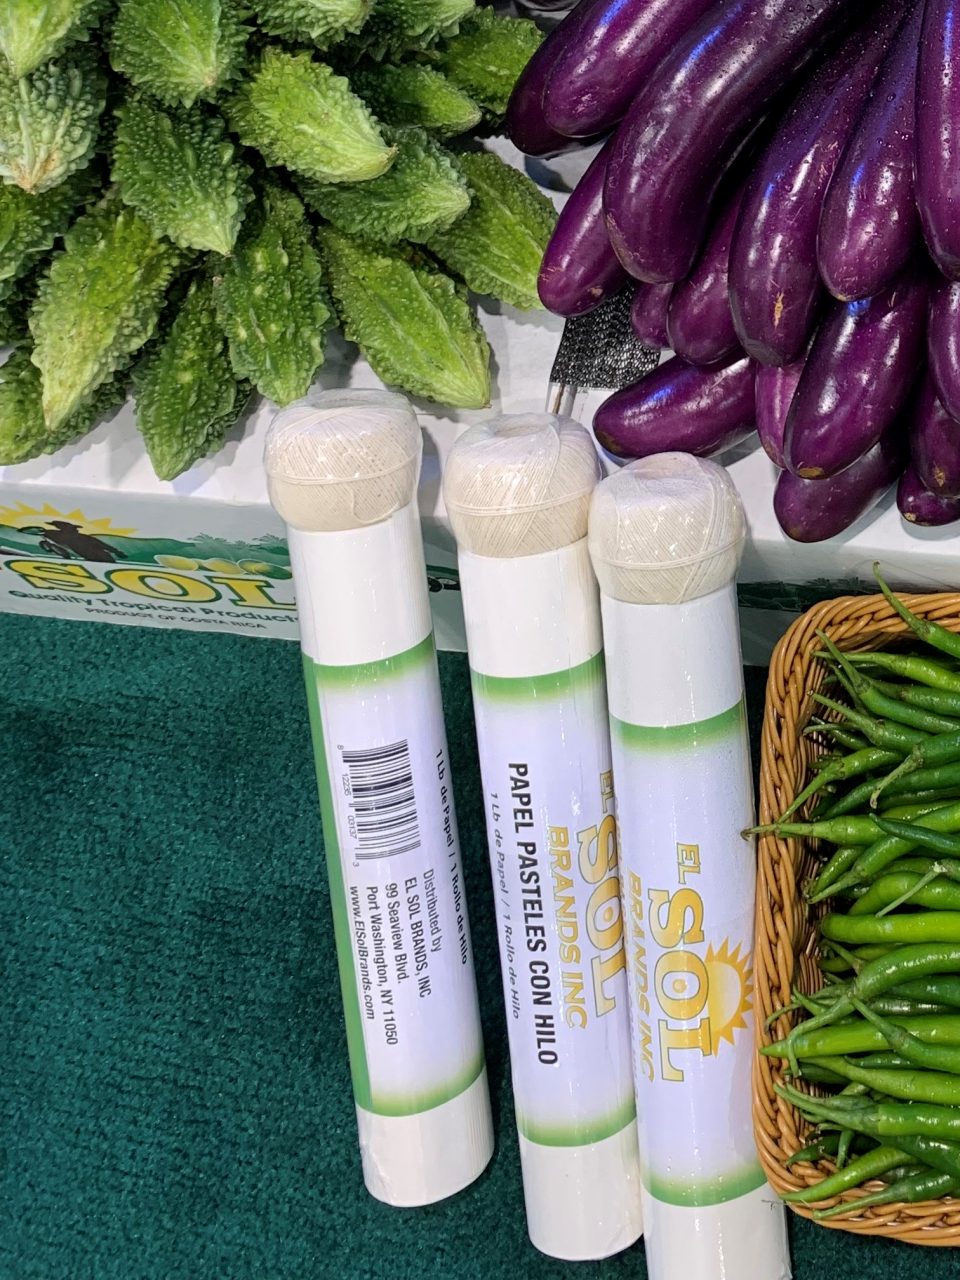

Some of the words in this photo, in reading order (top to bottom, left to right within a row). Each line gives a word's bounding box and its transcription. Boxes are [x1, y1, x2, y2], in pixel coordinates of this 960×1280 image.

[4, 559, 297, 611] SOL
[9, 589, 93, 606] Quality
[96, 596, 195, 615] Tropical
[85, 607, 153, 620] PRODUCT
[158, 613, 178, 622] OF
[180, 615, 226, 626] COSTA
[230, 619, 267, 630] RICA
[437, 760, 445, 780] Lb
[440, 785, 448, 803] de
[508, 763, 534, 834] PAPEL
[599, 768, 615, 814] EL
[443, 804, 454, 848] Papel
[491, 804, 501, 822] Lb
[494, 829, 503, 848] de
[496, 851, 509, 894] Papel
[676, 842, 701, 885] EL
[366, 886, 379, 911] Port
[385, 882, 398, 899] 99
[405, 876, 418, 894] EL
[423, 868, 442, 936] Distributed
[451, 876, 461, 912] Rollo
[517, 841, 547, 953] PASTELES
[549, 825, 581, 965] BRANDS
[387, 901, 405, 951] Seaview
[406, 896, 421, 920] SOL
[457, 913, 463, 932] de
[576, 815, 628, 1018] SOL
[350, 886, 375, 1020] www.ElSolBrands.com
[369, 913, 388, 987] Washington,
[410, 921, 429, 977] BRANDS,
[431, 938, 443, 953] by
[459, 934, 467, 965] Hilo
[504, 924, 515, 963] Rollo
[628, 867, 651, 1012] BRANDS
[394, 952, 410, 984] Blvd.
[418, 976, 432, 998] INC
[509, 967, 518, 986] de
[529, 960, 554, 1006] CON
[648, 887, 712, 1082] SOL
[381, 989, 394, 1006] NY
[510, 988, 520, 1019] Hilo
[561, 972, 588, 1029] INC
[383, 1009, 398, 1046] 11050
[534, 1014, 558, 1065] HILO
[638, 1019, 655, 1083] INC
